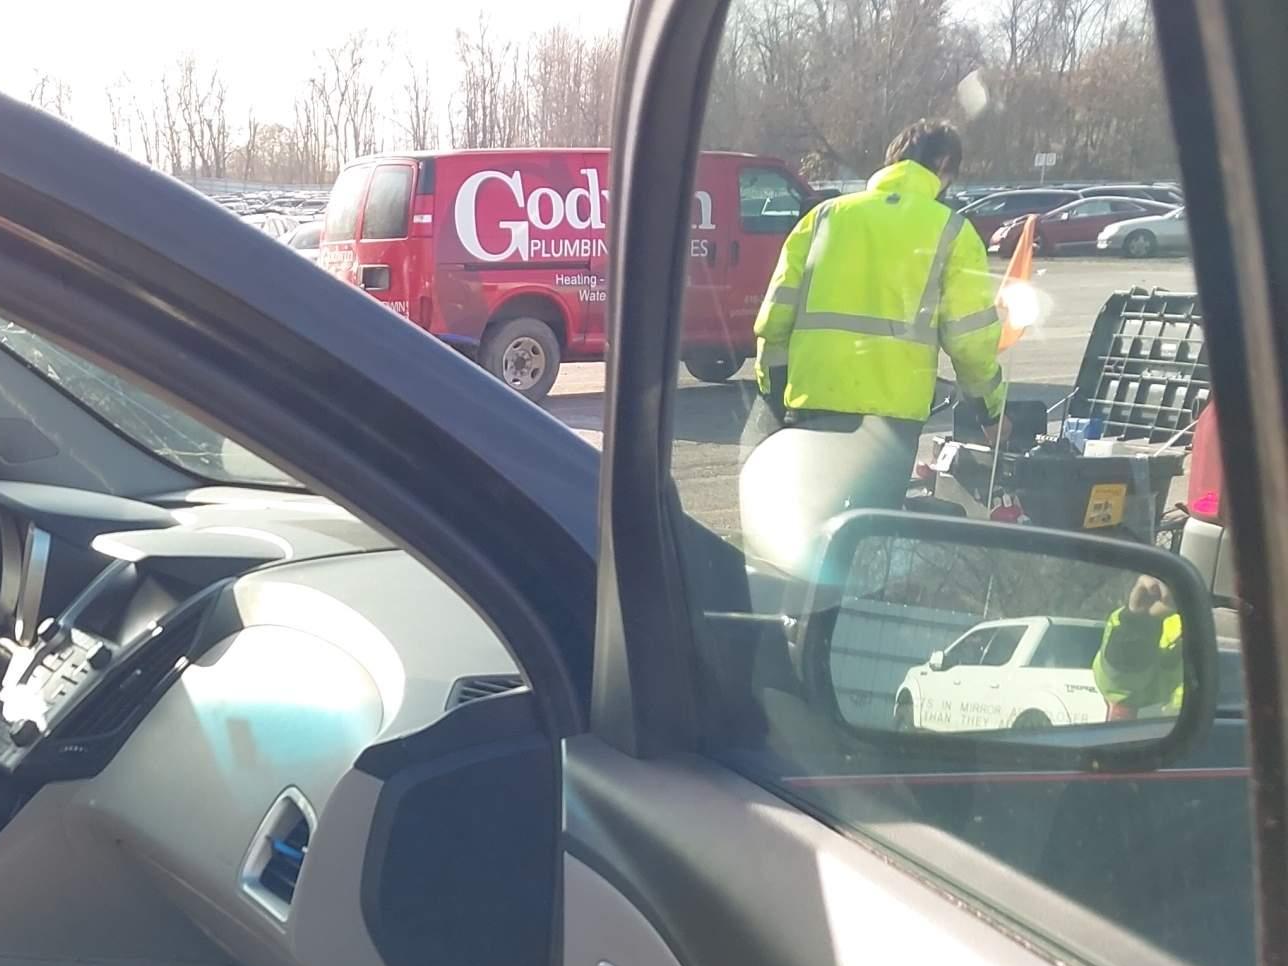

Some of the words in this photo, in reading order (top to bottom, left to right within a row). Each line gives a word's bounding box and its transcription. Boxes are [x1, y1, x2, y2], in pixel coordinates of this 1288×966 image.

[455, 168, 716, 262] Godn
[530, 239, 609, 258] PLUMBIN
[555, 273, 598, 288] Heating
[579, 289, 607, 302] Wate
